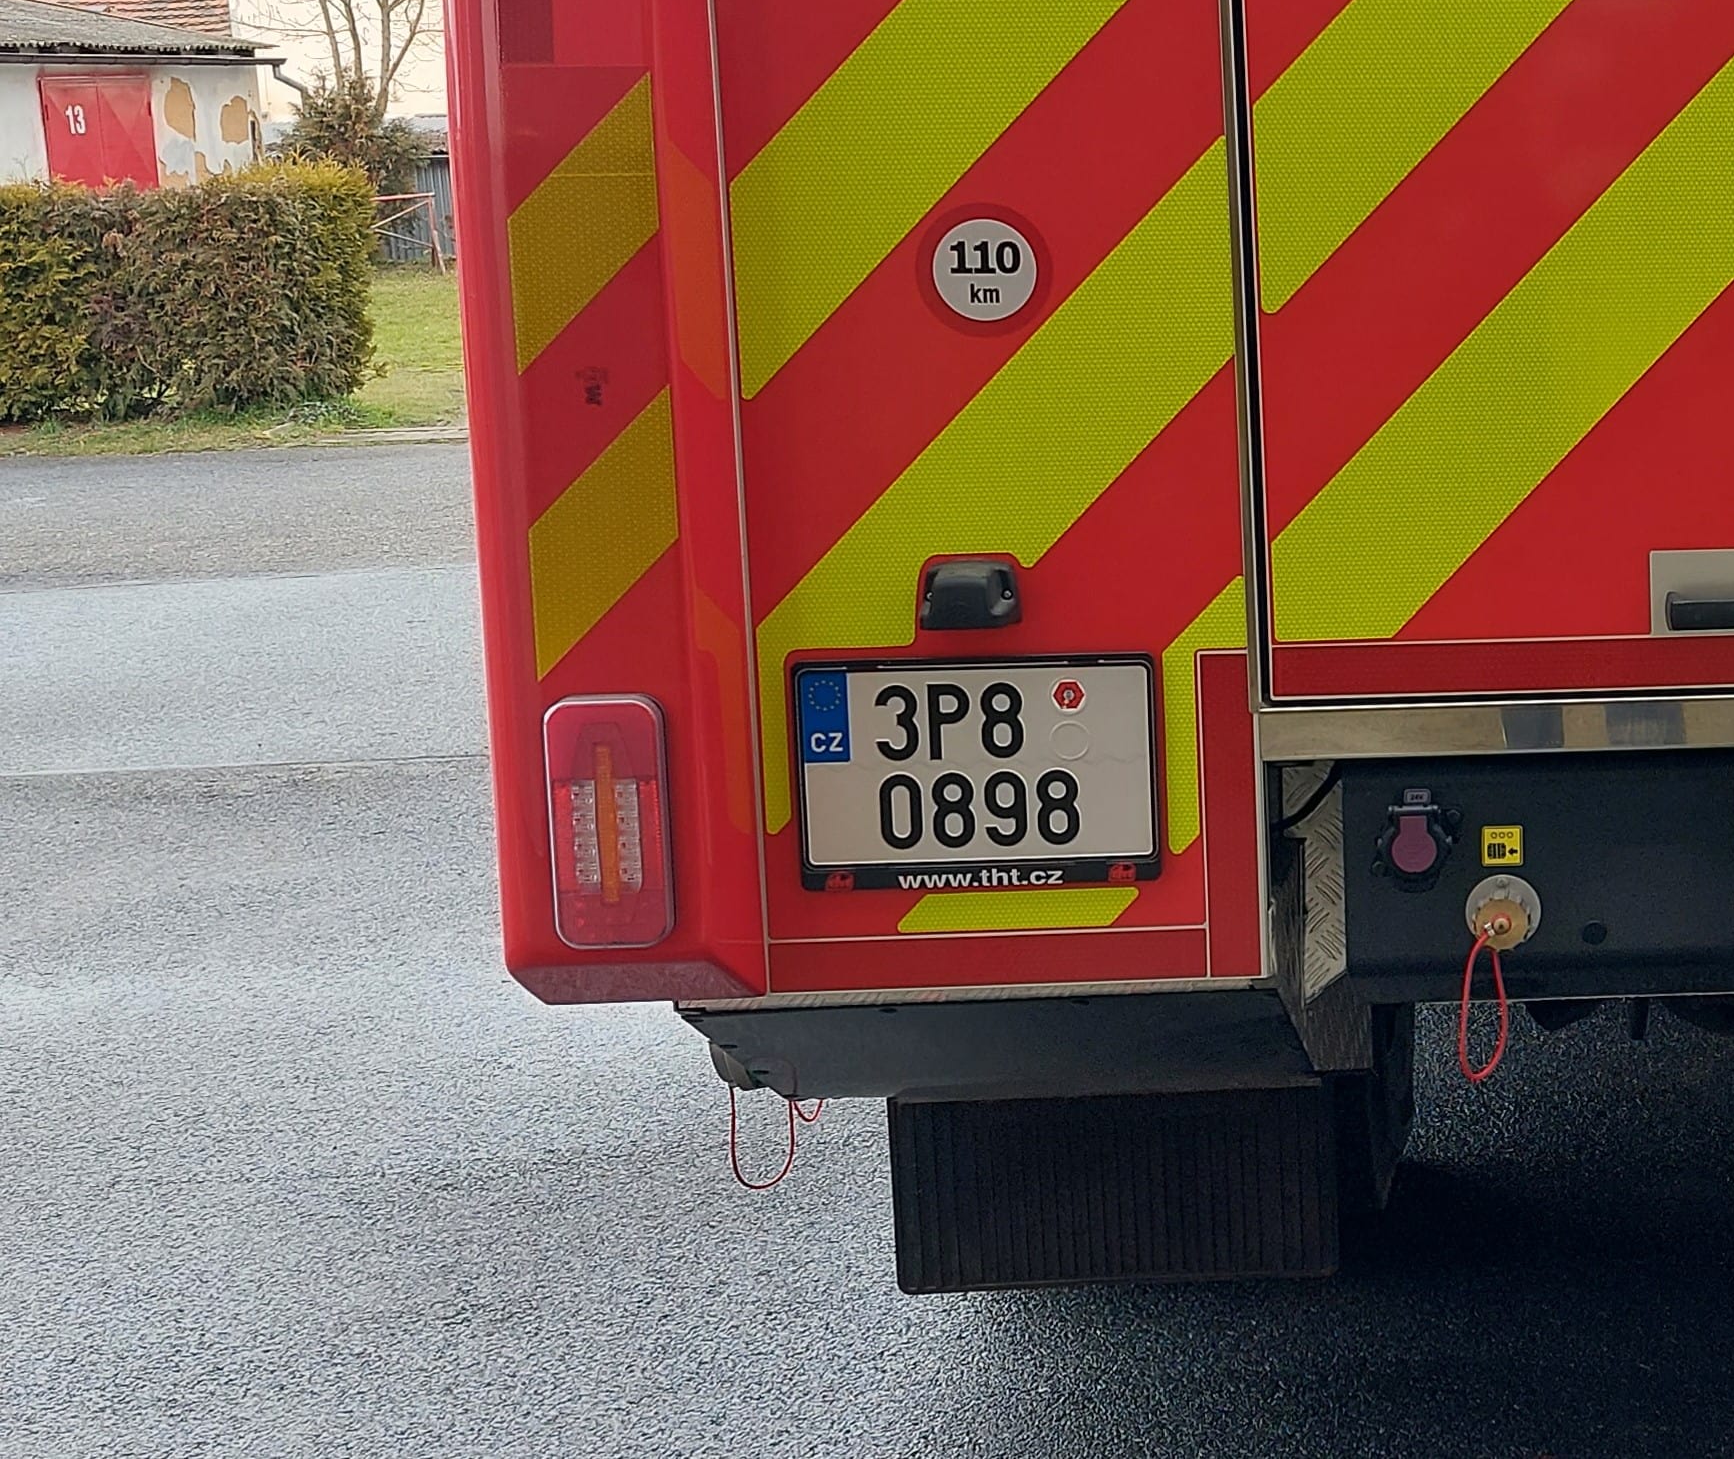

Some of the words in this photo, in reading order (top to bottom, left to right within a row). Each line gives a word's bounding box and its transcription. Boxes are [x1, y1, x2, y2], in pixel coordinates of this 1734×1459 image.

[65, 104, 86, 135] 13
[949, 240, 1022, 275] 110
[969, 283, 1001, 304] km
[873, 681, 1026, 762] 3P8
[810, 731, 844, 753] CZ
[878, 768, 1082, 850] 0898
[897, 867, 1065, 890] www.tht.cz
